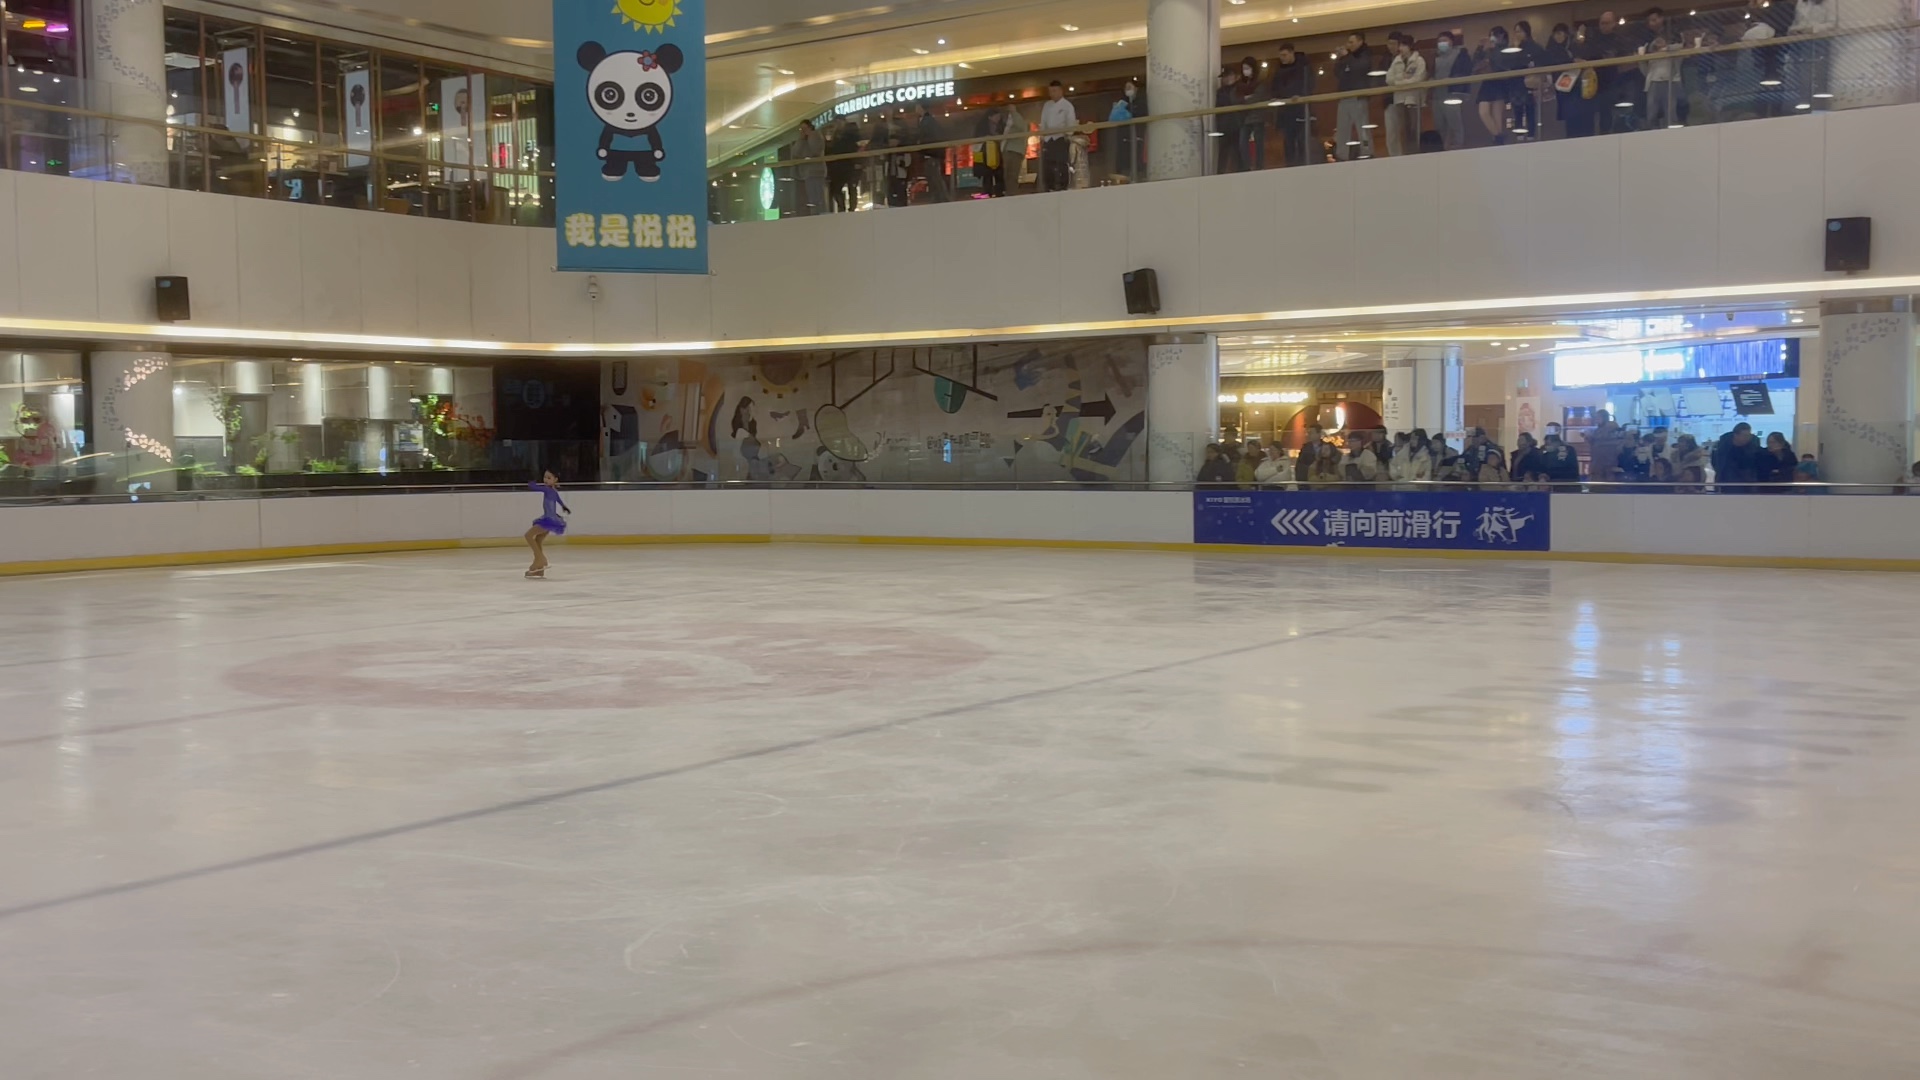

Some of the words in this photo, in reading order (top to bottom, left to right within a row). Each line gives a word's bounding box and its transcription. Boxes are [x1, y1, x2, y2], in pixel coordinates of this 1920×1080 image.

[834, 90, 894, 115] STARBUCKS
[895, 81, 955, 102] COFFEE
[564, 212, 697, 248] 我是悦悦
[1323, 508, 1462, 539] 请向前滑行
